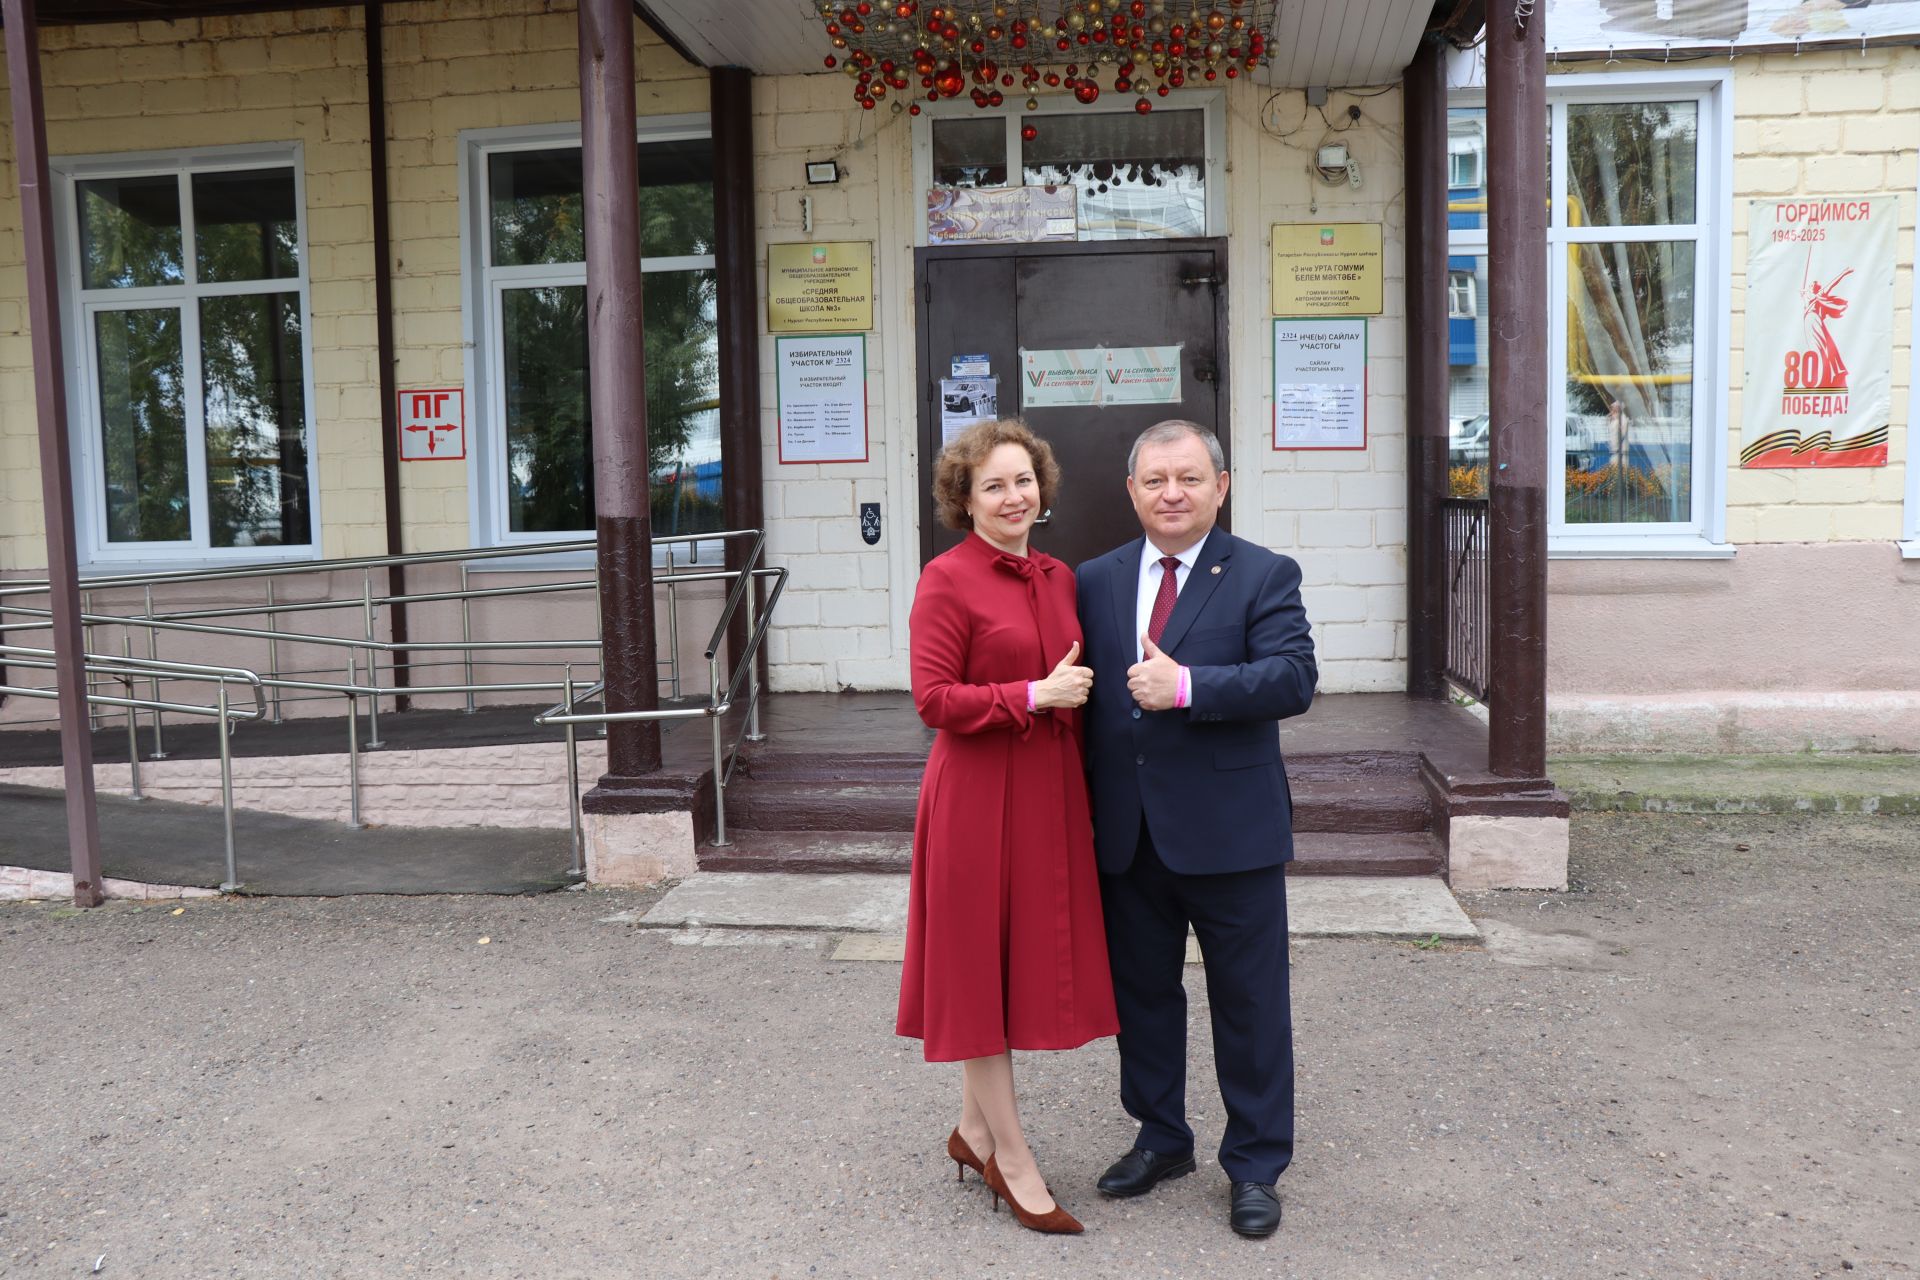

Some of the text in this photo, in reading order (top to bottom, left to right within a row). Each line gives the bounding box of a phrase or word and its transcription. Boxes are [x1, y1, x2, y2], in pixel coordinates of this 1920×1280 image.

[1776, 202, 1871, 225] ГОРДИМСЯ
[1771, 228, 1826, 243] 1945-2025
[1334, 264, 1365, 272] ГОМУМИ
[1322, 273, 1357, 281] МӘКТӘБЕ
[776, 296, 866, 304] ОБЩЕОБРАЗОВАТЕЛЬНАЯ
[799, 304, 825, 312] ШКОЛА
[1299, 333, 1327, 341] НЧЕ(Ы)
[1328, 331, 1360, 340] САЙЛАУ
[789, 349, 853, 358] ИЗБИРАТЕЛЬНЫЙ
[791, 359, 824, 367] УЧАСТОК
[1783, 350, 1819, 388] 80
[413, 394, 449, 418] ПГ
[1781, 395, 1849, 418] ПОБЕДА!
